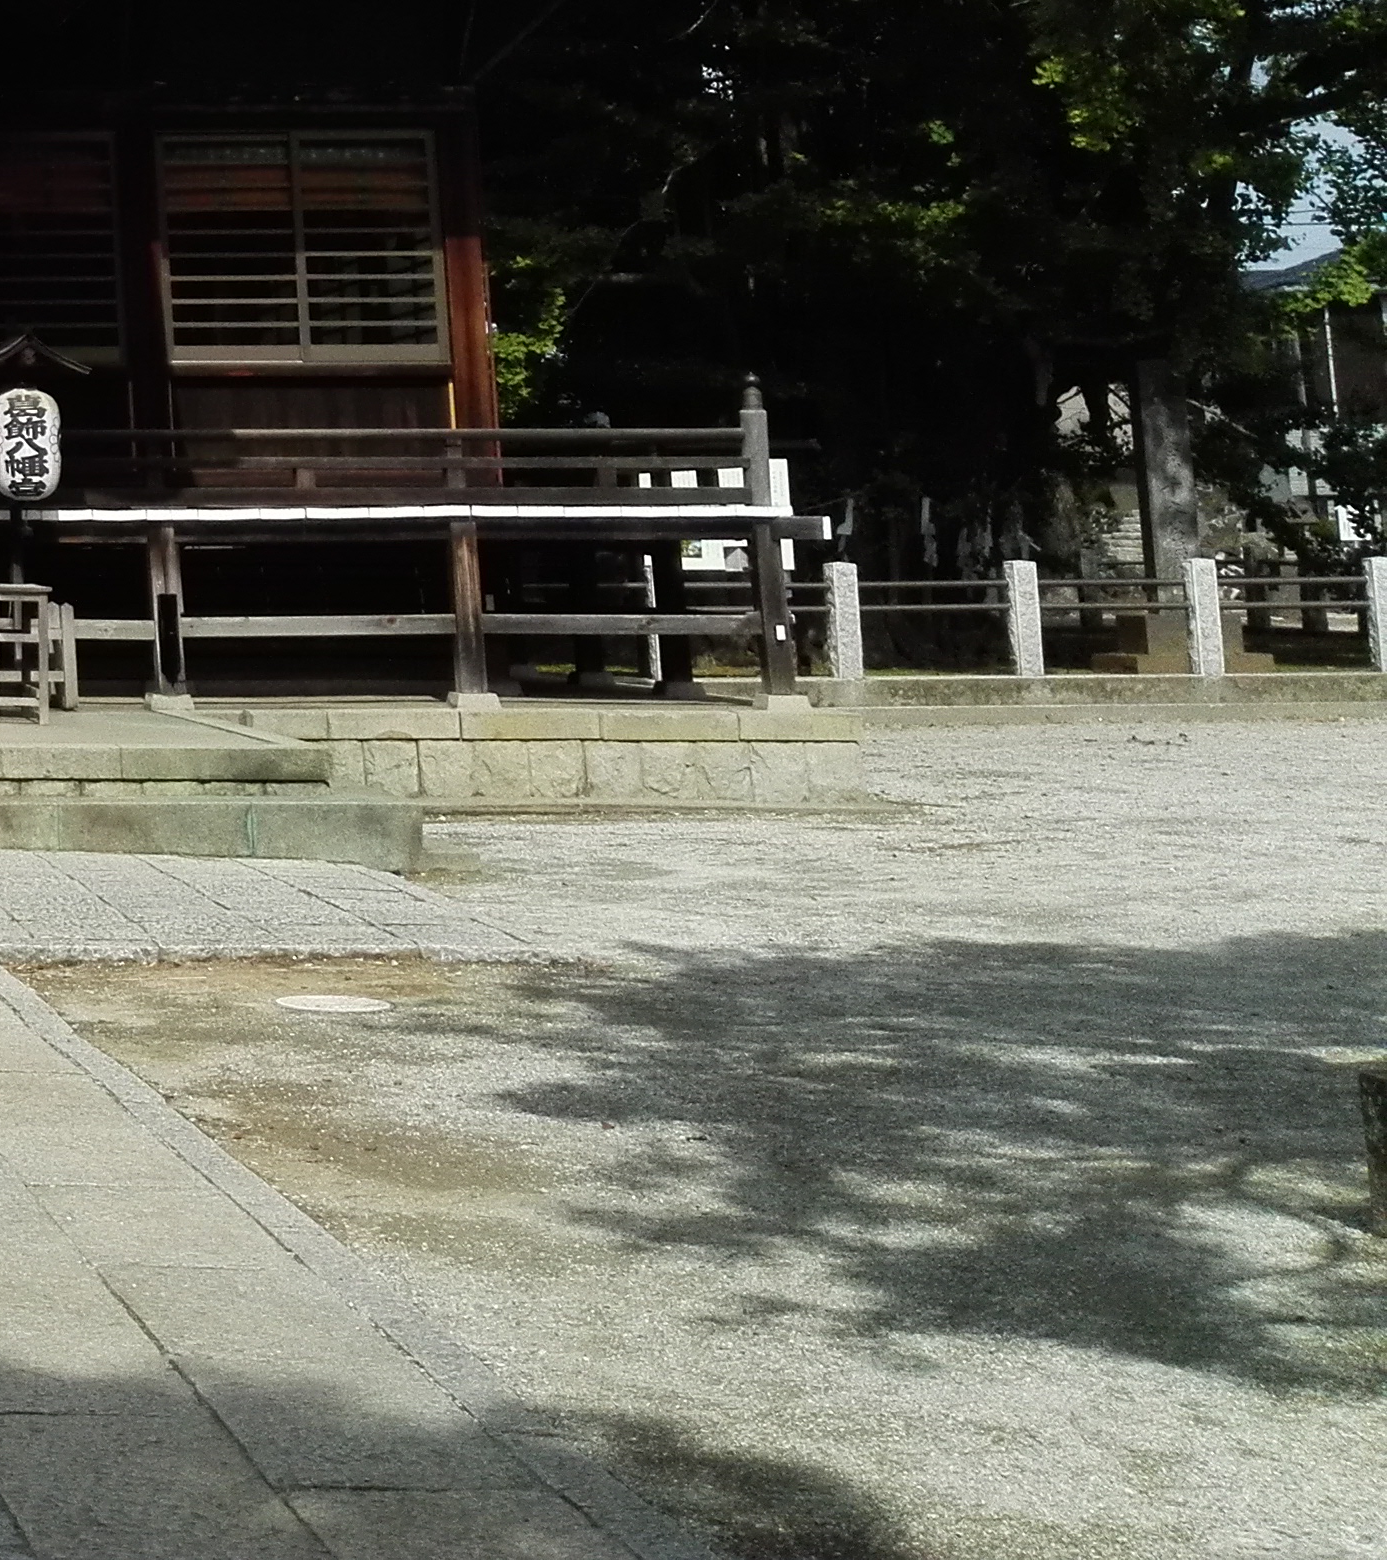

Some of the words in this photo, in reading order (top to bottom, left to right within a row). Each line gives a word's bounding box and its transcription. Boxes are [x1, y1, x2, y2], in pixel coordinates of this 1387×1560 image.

[3, 394, 50, 497] 葛飾八幡宮
